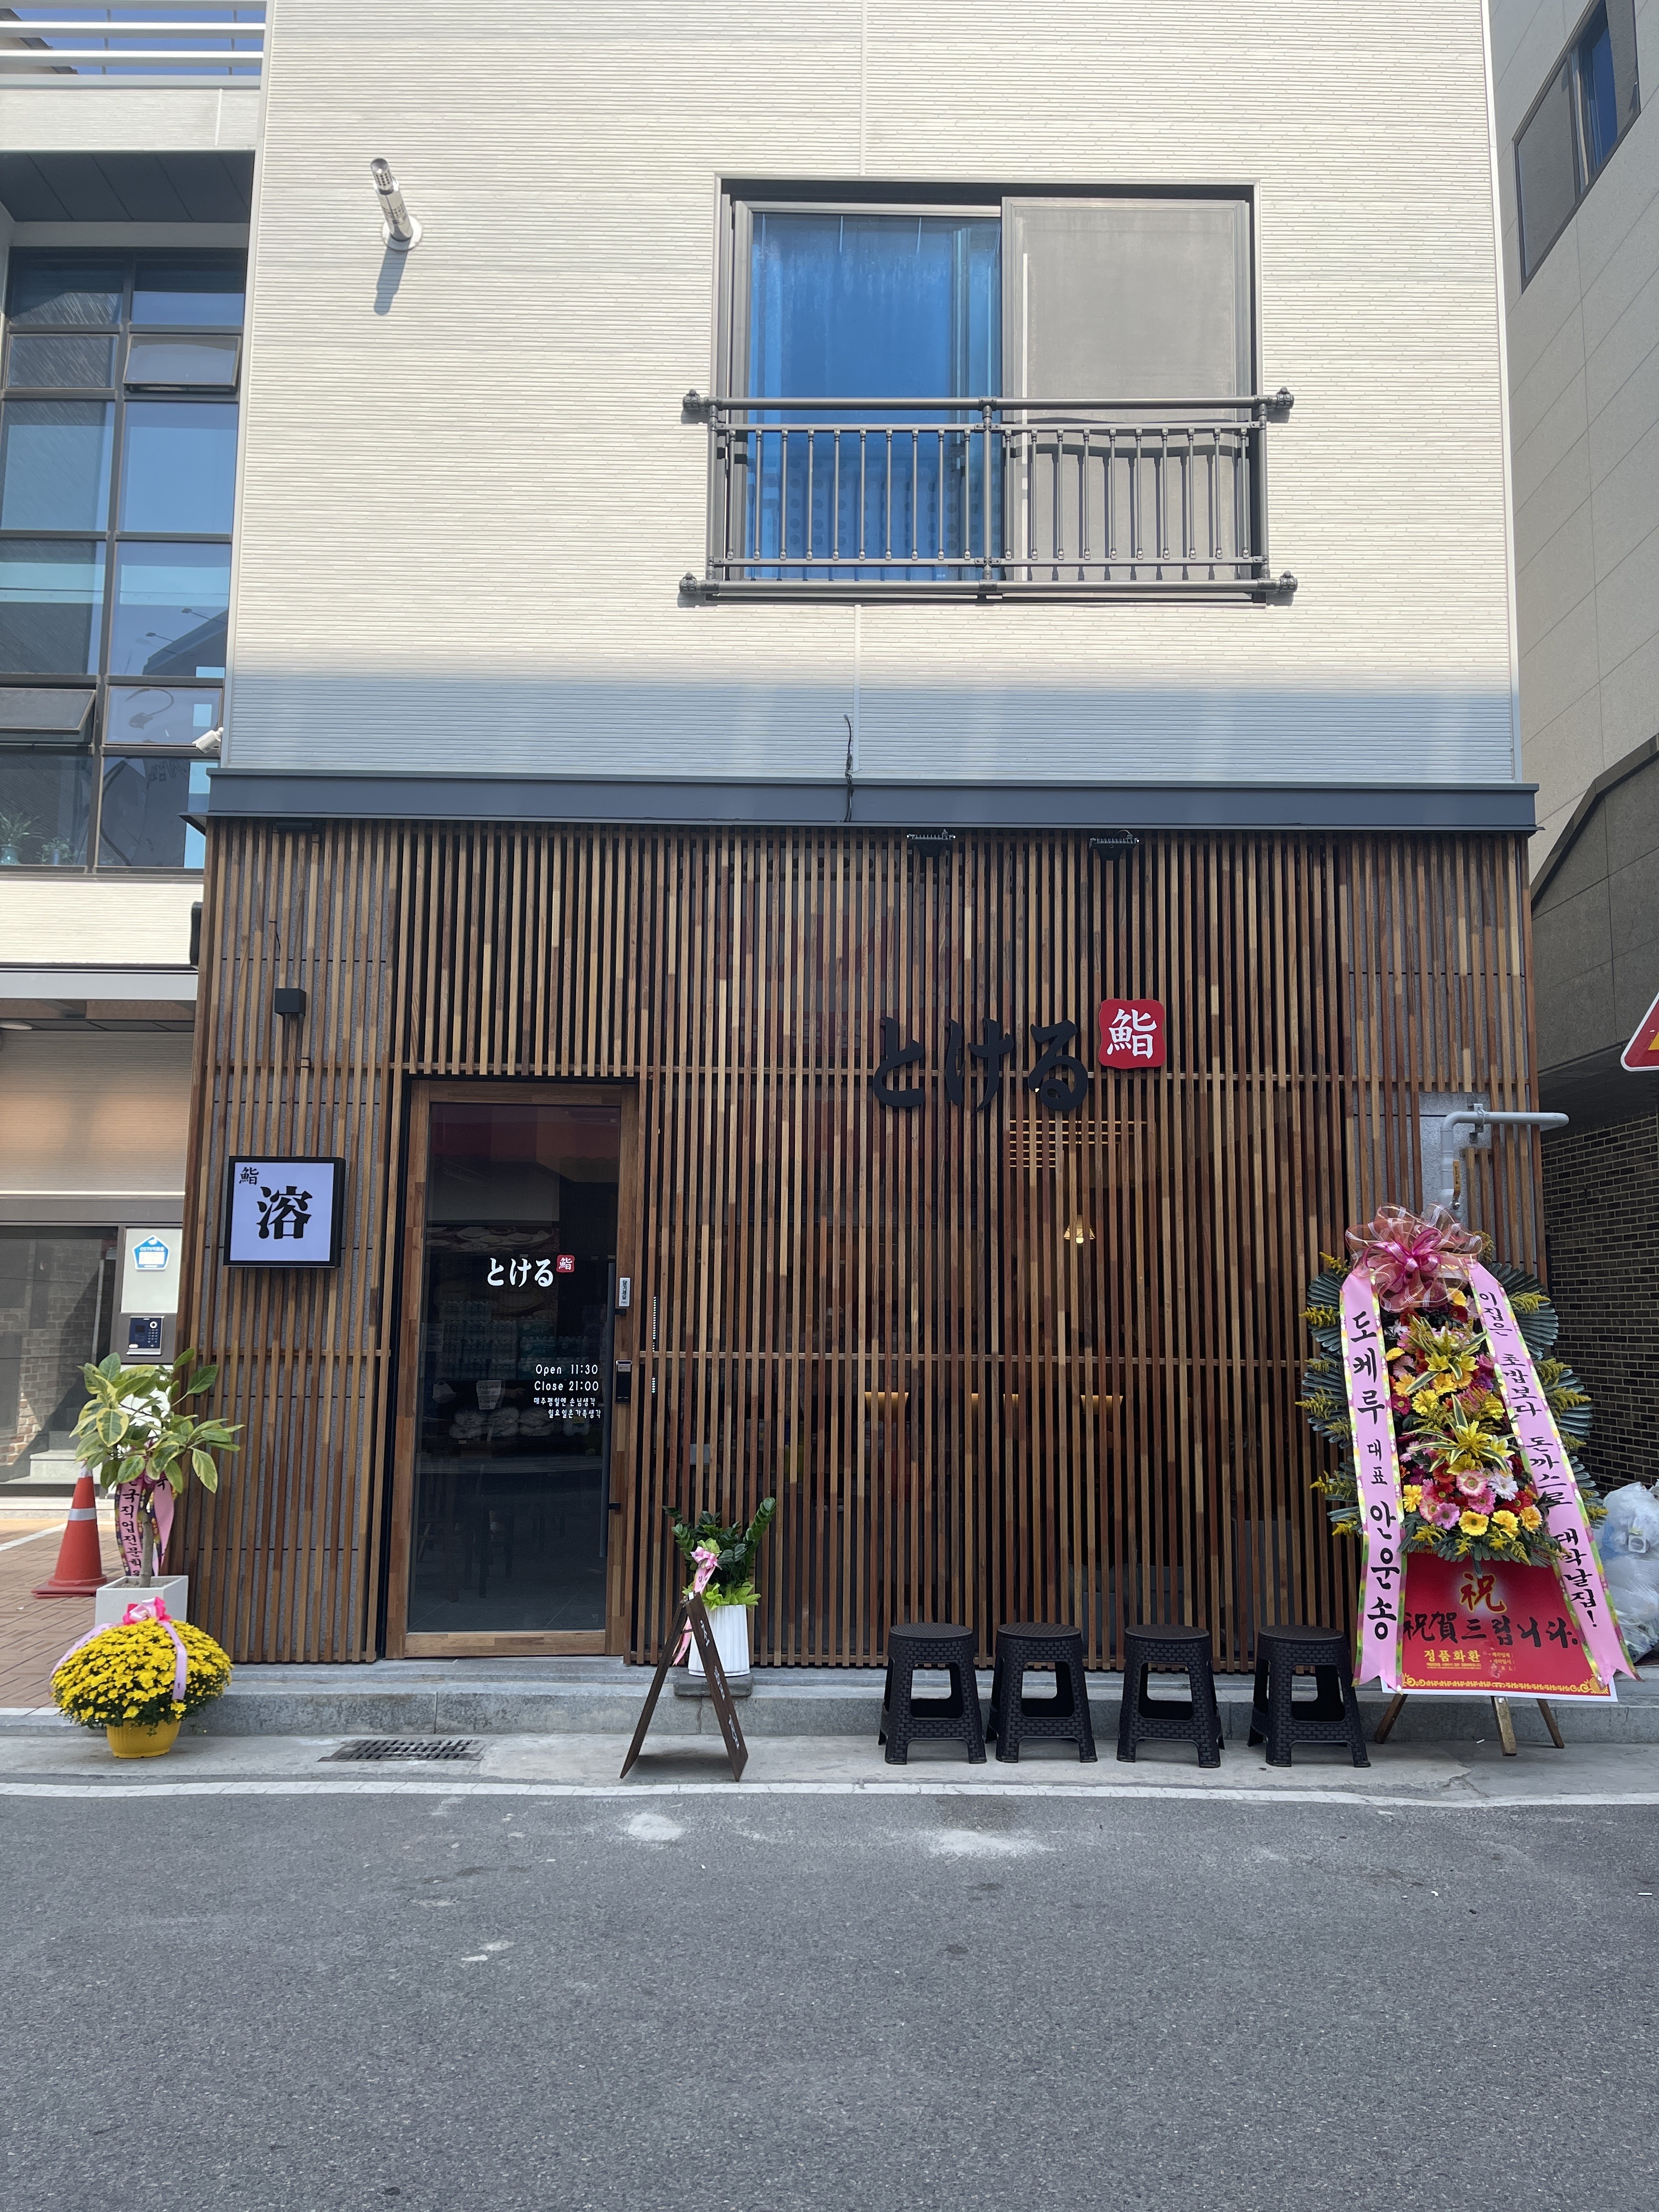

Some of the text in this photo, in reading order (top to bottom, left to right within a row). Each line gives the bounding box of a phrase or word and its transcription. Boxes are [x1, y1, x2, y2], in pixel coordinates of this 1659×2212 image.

[873, 1008, 1158, 1113] とける 鮨
[239, 1166, 259, 1186] 鮨
[256, 1186, 313, 1240] 溶
[487, 1256, 573, 1288] とける 鮨
[534, 1380, 599, 1391] Close 21:00
[535, 1364, 599, 1376] Open 11:30
[1479, 1291, 1513, 1336] 이집은
[1500, 1353, 1543, 1417] 초밥보다
[1525, 1436, 1573, 1509] 돈까스로
[1350, 1311, 1401, 1640] 도케루 대표 안운송
[1460, 1572, 1508, 1613] 祝
[1424, 1649, 1481, 1663] 정품화환
